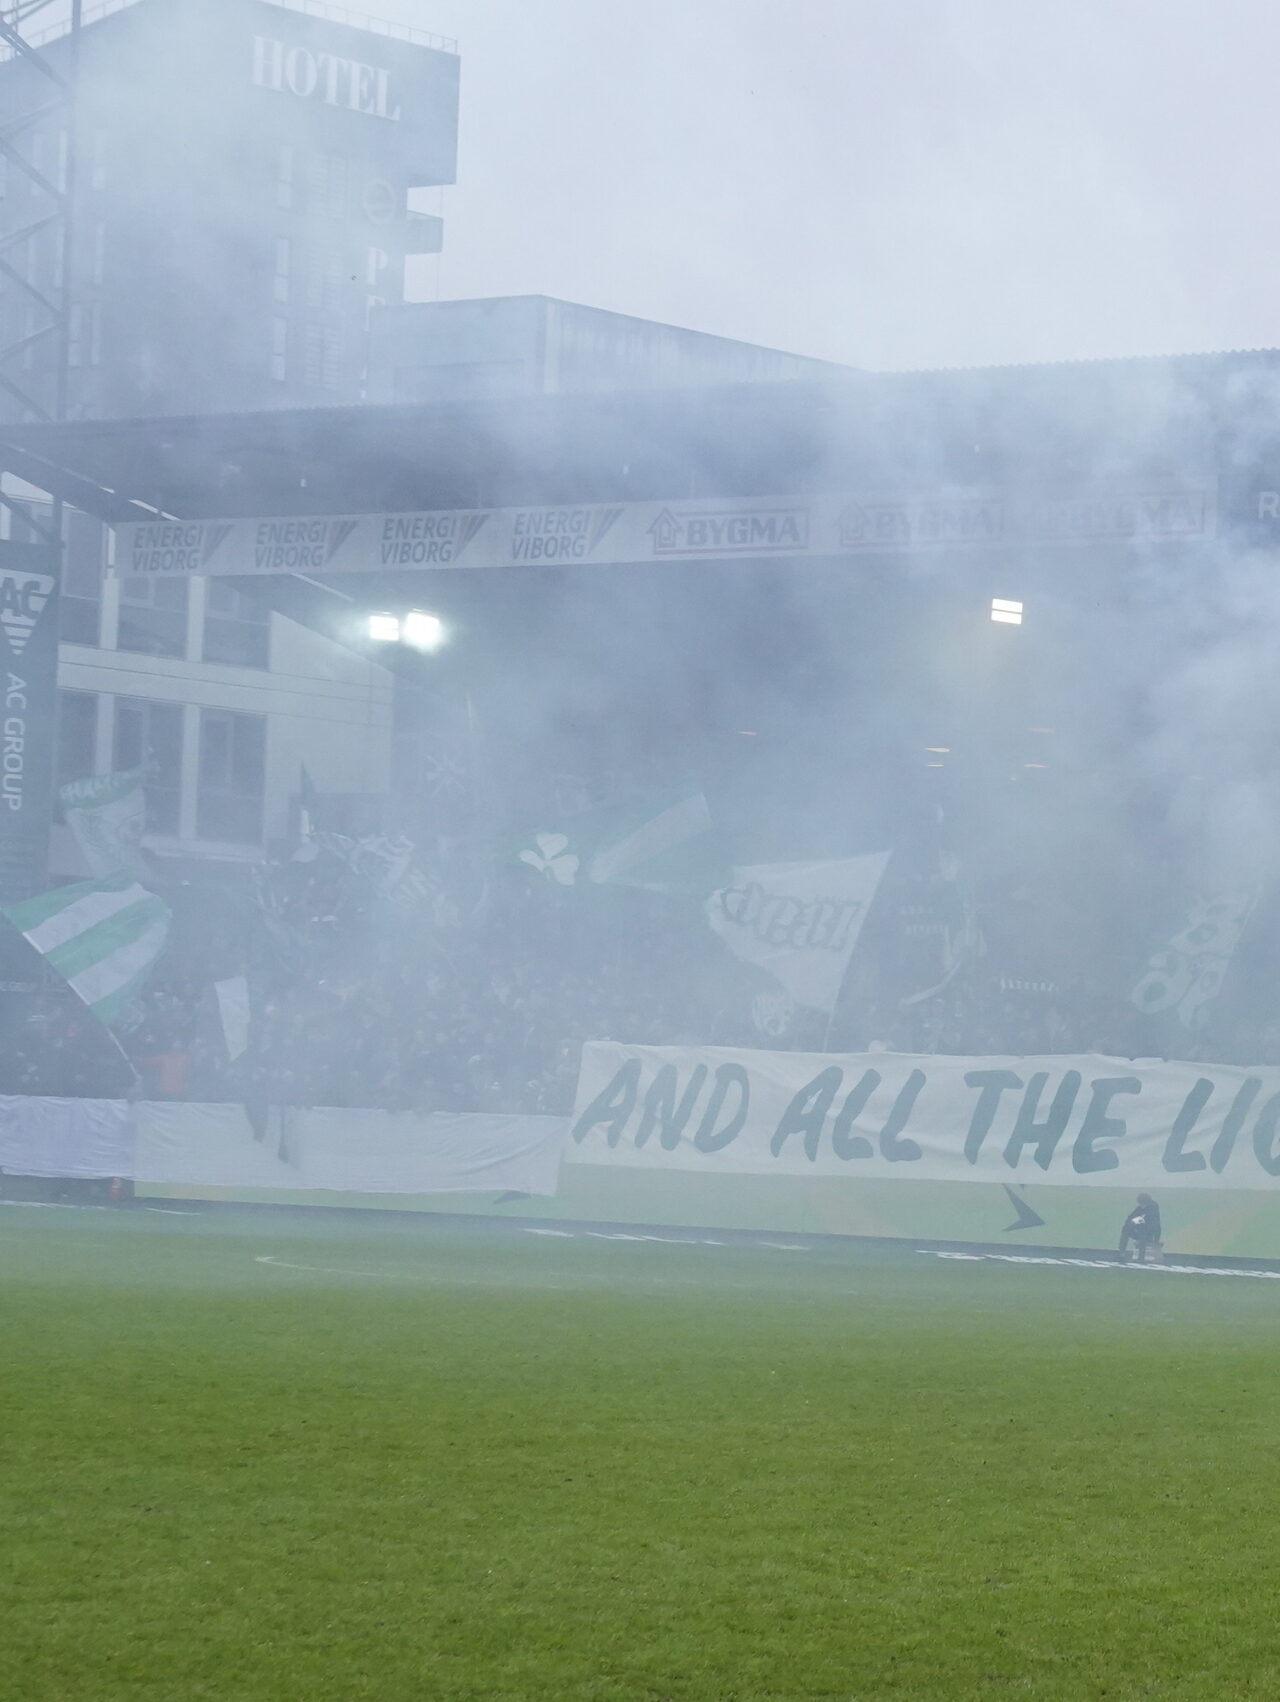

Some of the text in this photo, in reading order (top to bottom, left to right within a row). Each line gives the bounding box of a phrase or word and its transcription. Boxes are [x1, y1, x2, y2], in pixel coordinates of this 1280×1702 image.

[252, 34, 400, 120] HOTEL
[255, 519, 328, 545] ENERGI
[382, 515, 458, 540] ENERGI
[514, 509, 590, 535] ENERGI
[686, 514, 800, 546] BYGMA
[133, 524, 204, 549] ENERGI
[511, 535, 587, 560] VIBORG
[131, 549, 201, 572] VIBORG
[254, 545, 326, 569] VIBORG
[380, 540, 454, 565] VIBORG
[2, 671, 27, 812] AC GROUP
[572, 1057, 750, 1153] AND
[769, 1065, 927, 1162] ALL
[963, 1069, 1142, 1174] THE
